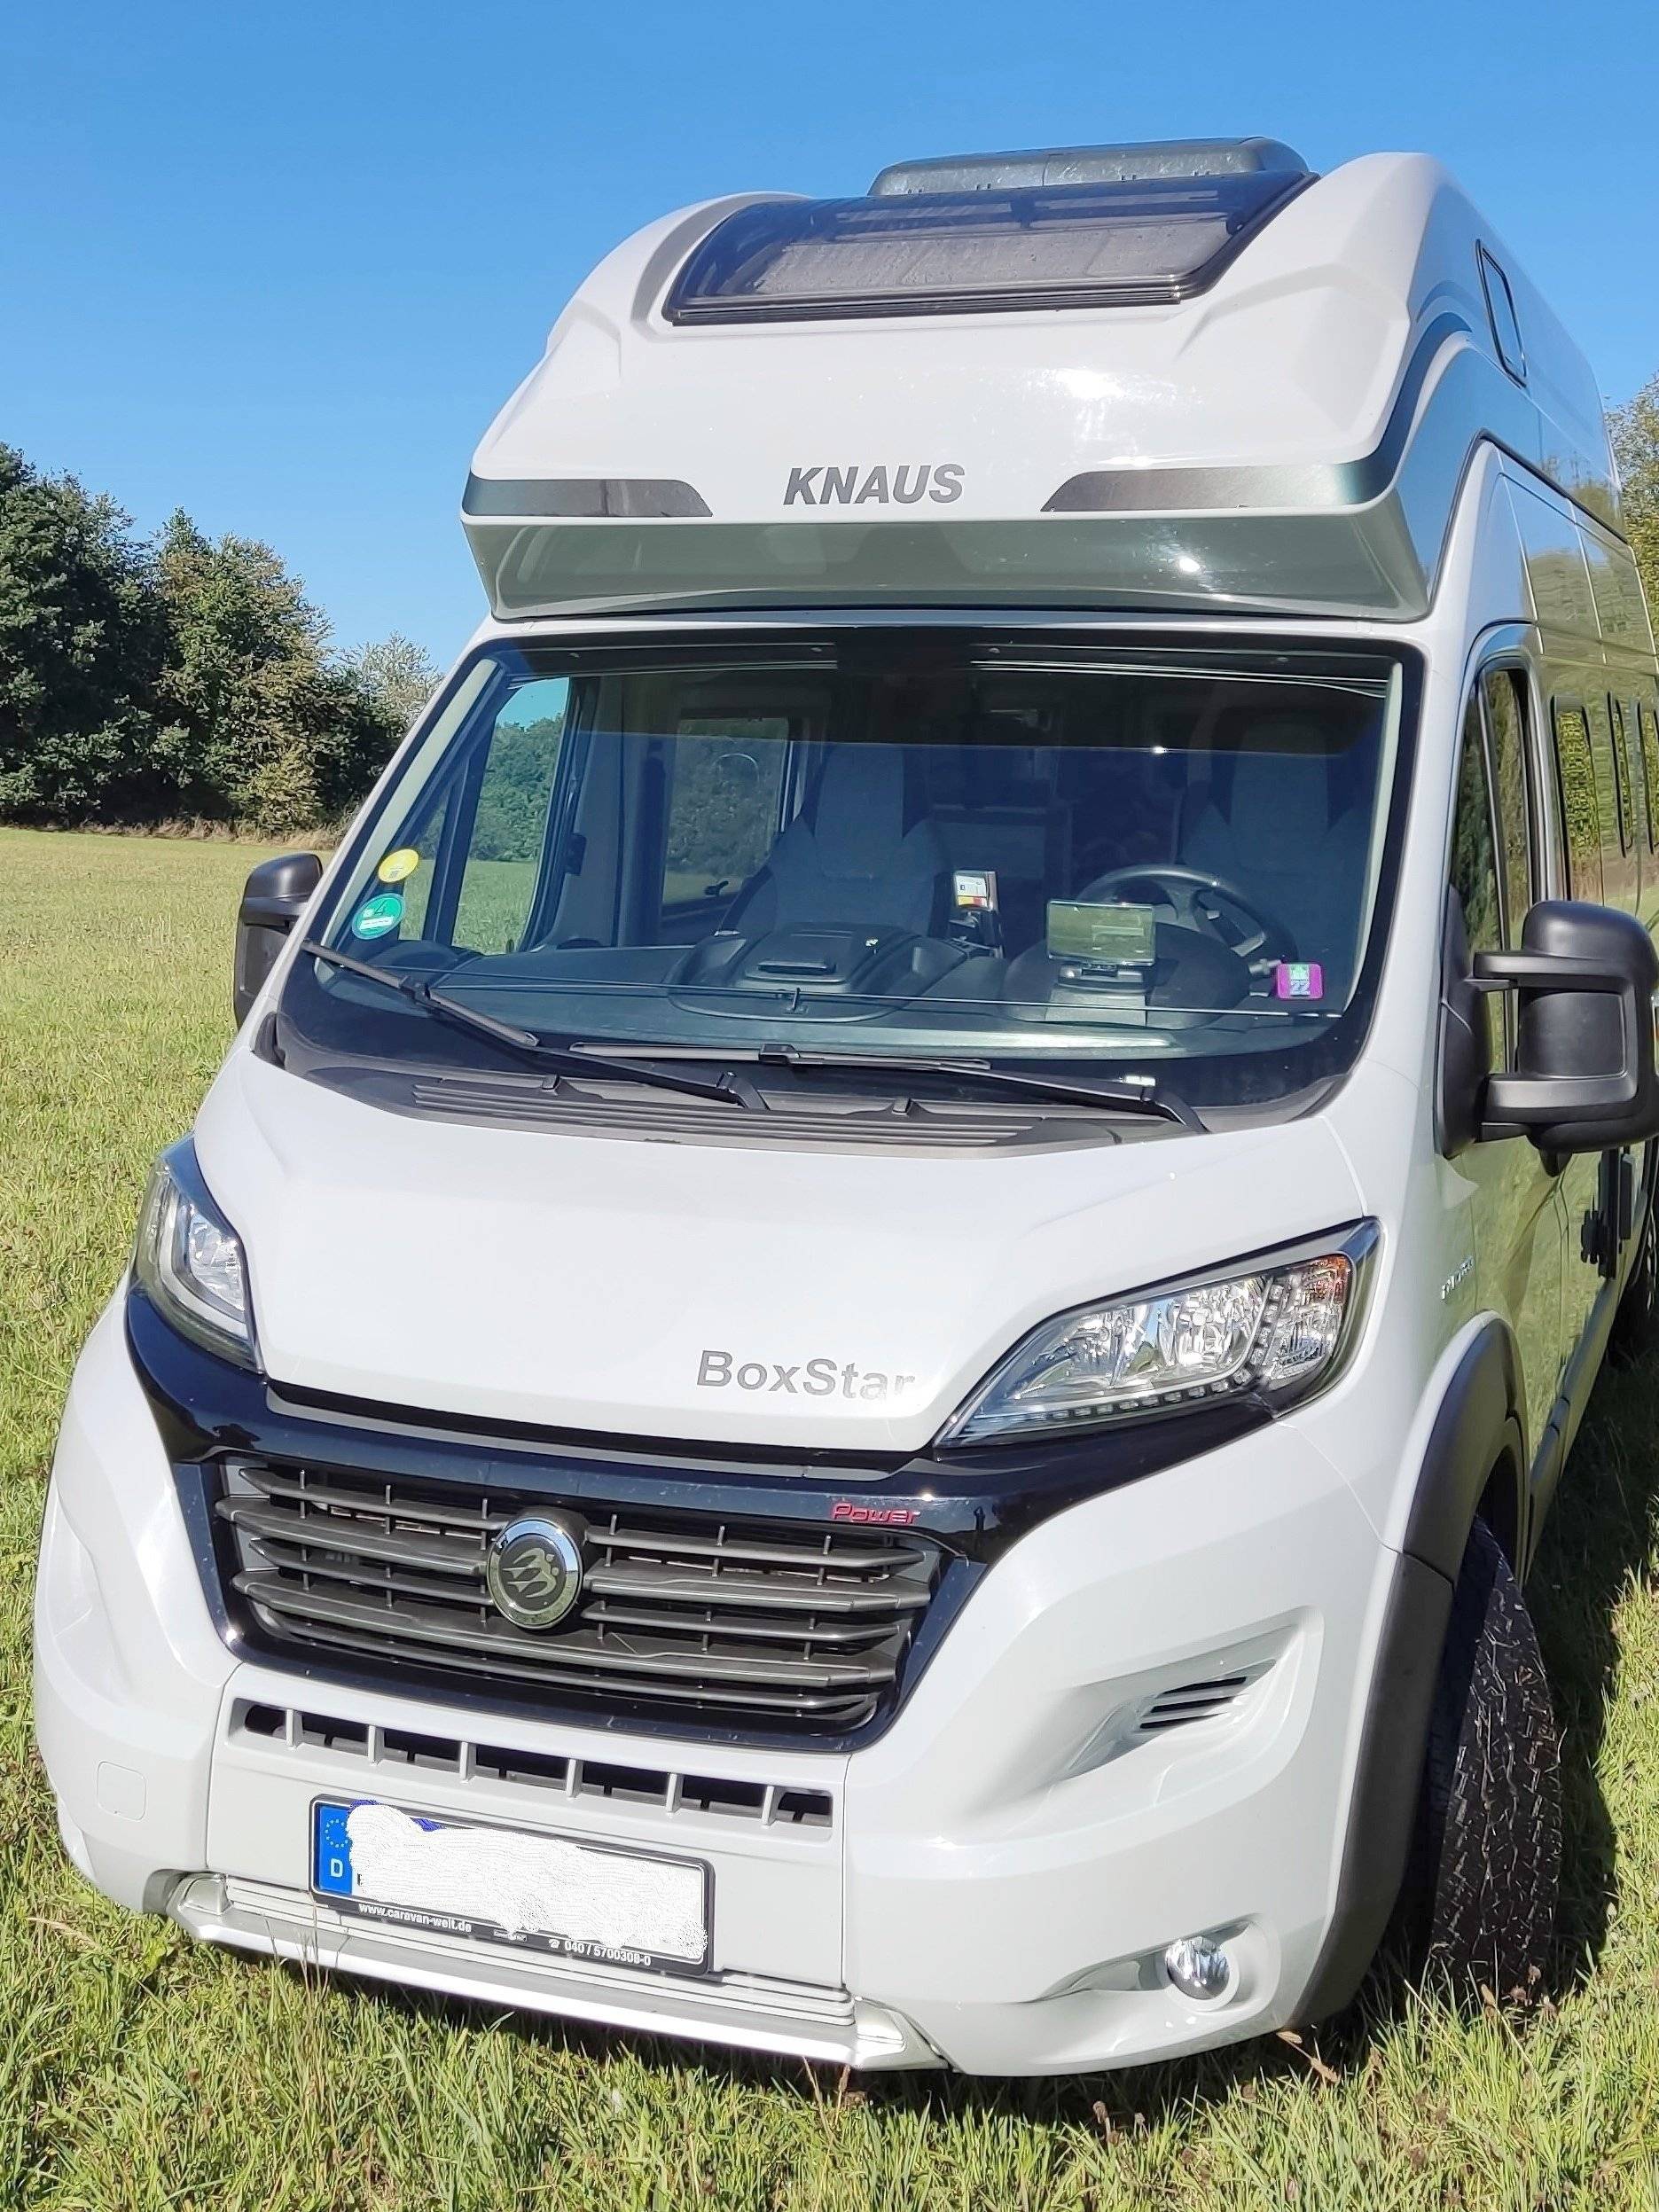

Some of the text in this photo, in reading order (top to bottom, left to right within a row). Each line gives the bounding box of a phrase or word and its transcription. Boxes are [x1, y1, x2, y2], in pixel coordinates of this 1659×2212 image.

[783, 464, 966, 505] KNAUS
[697, 1349, 916, 1401] BoxStar
[832, 1501, 921, 1523] Power
[330, 1857, 343, 1878] D
[564, 1939, 585, 1955] 040
